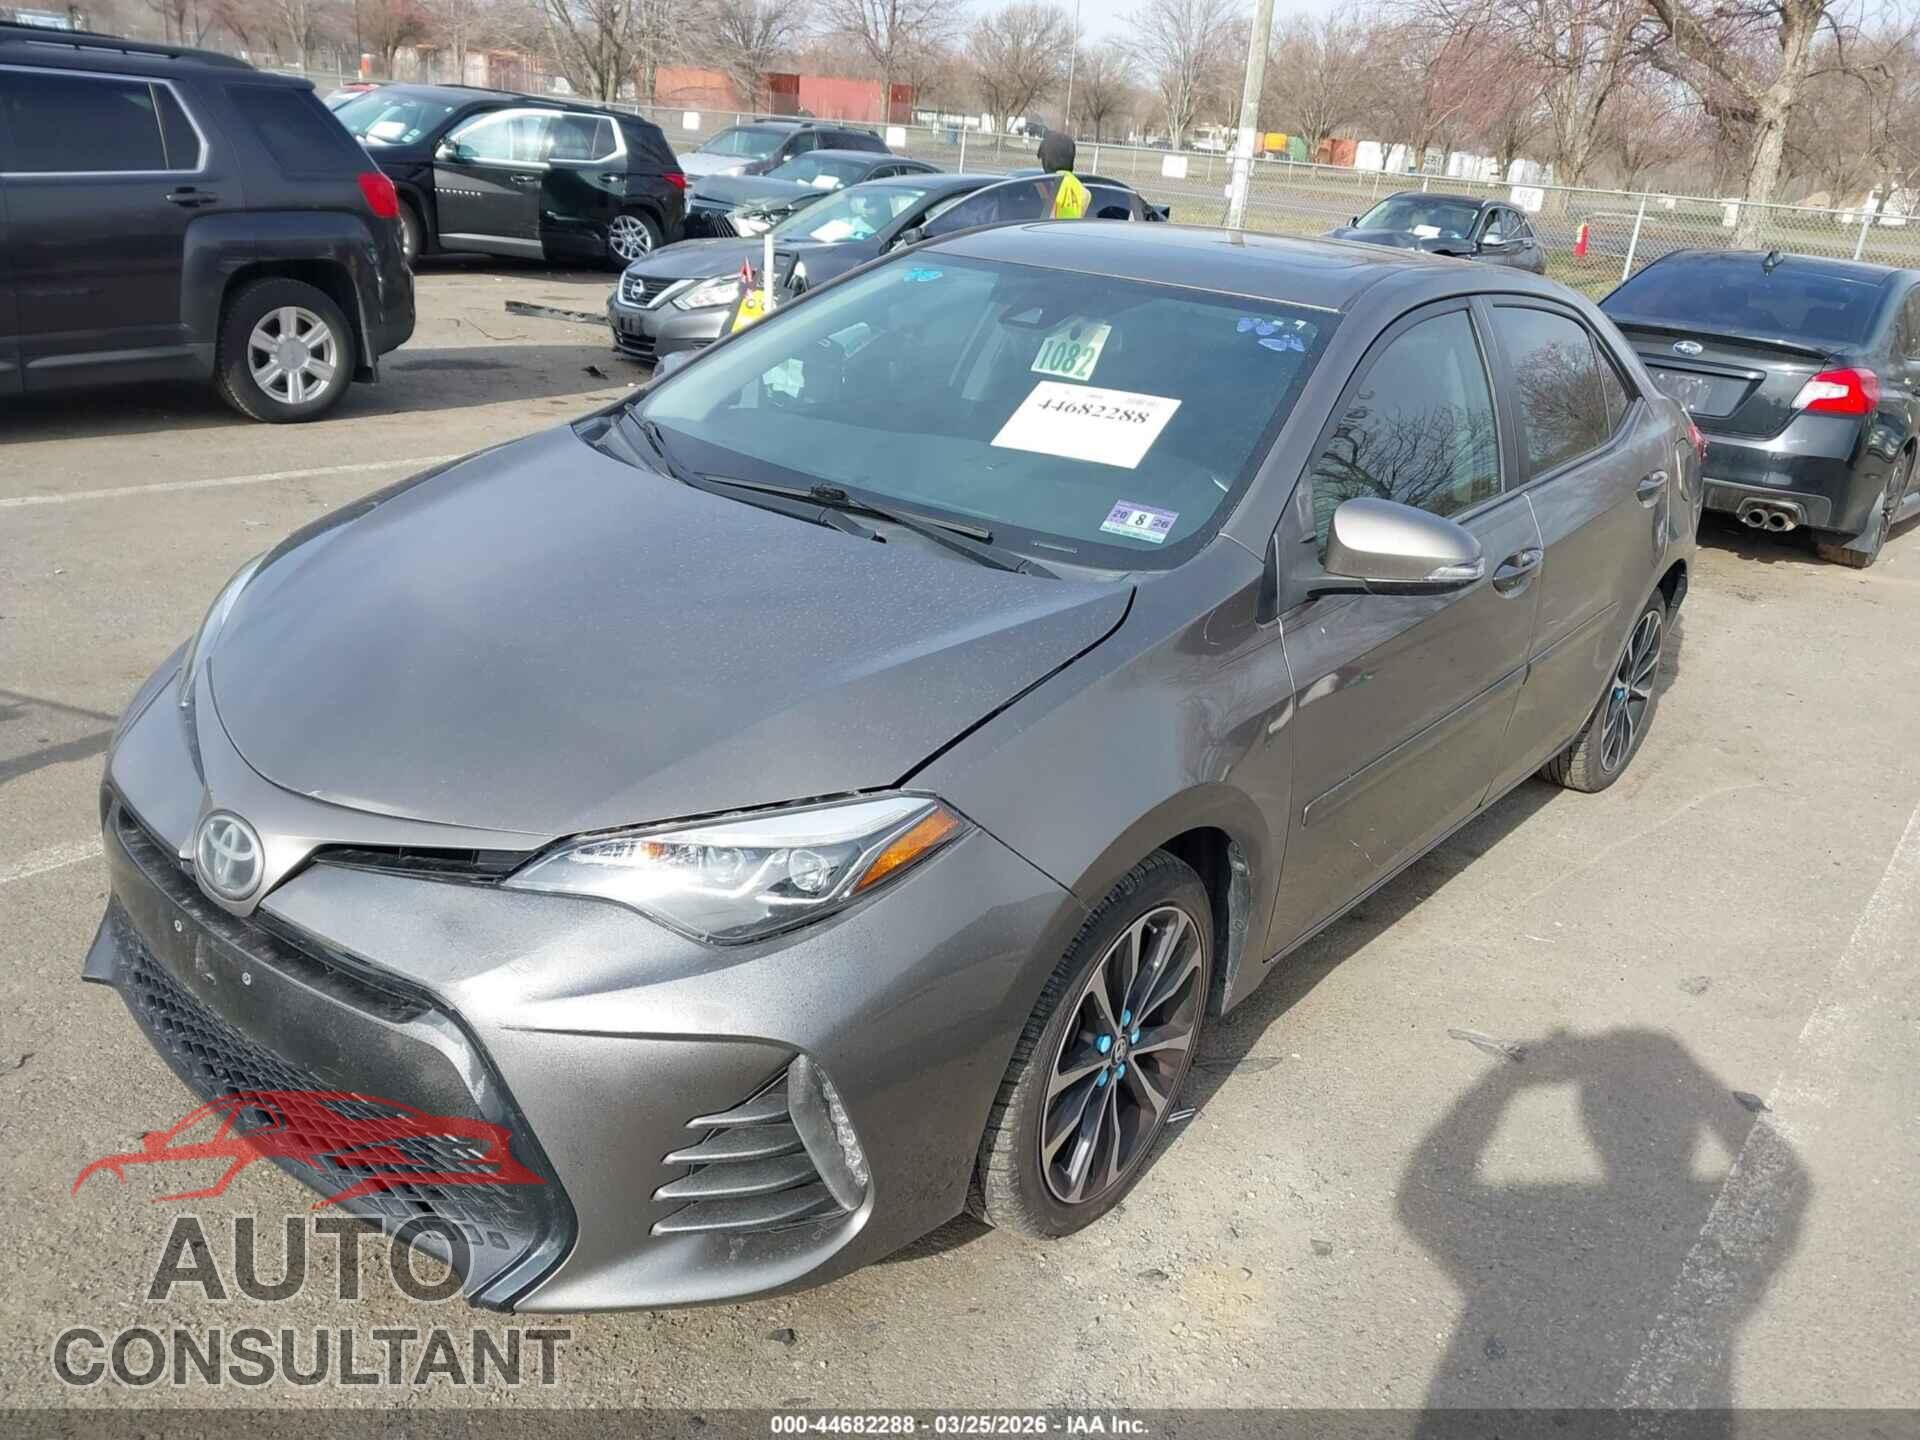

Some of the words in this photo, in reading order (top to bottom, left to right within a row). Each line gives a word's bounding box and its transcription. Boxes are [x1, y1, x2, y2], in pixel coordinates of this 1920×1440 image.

[1038, 340, 1096, 377] 1082
[1037, 398, 1150, 424] 44682288
[1134, 513, 1148, 526] 8
[1152, 519, 1171, 529] 26
